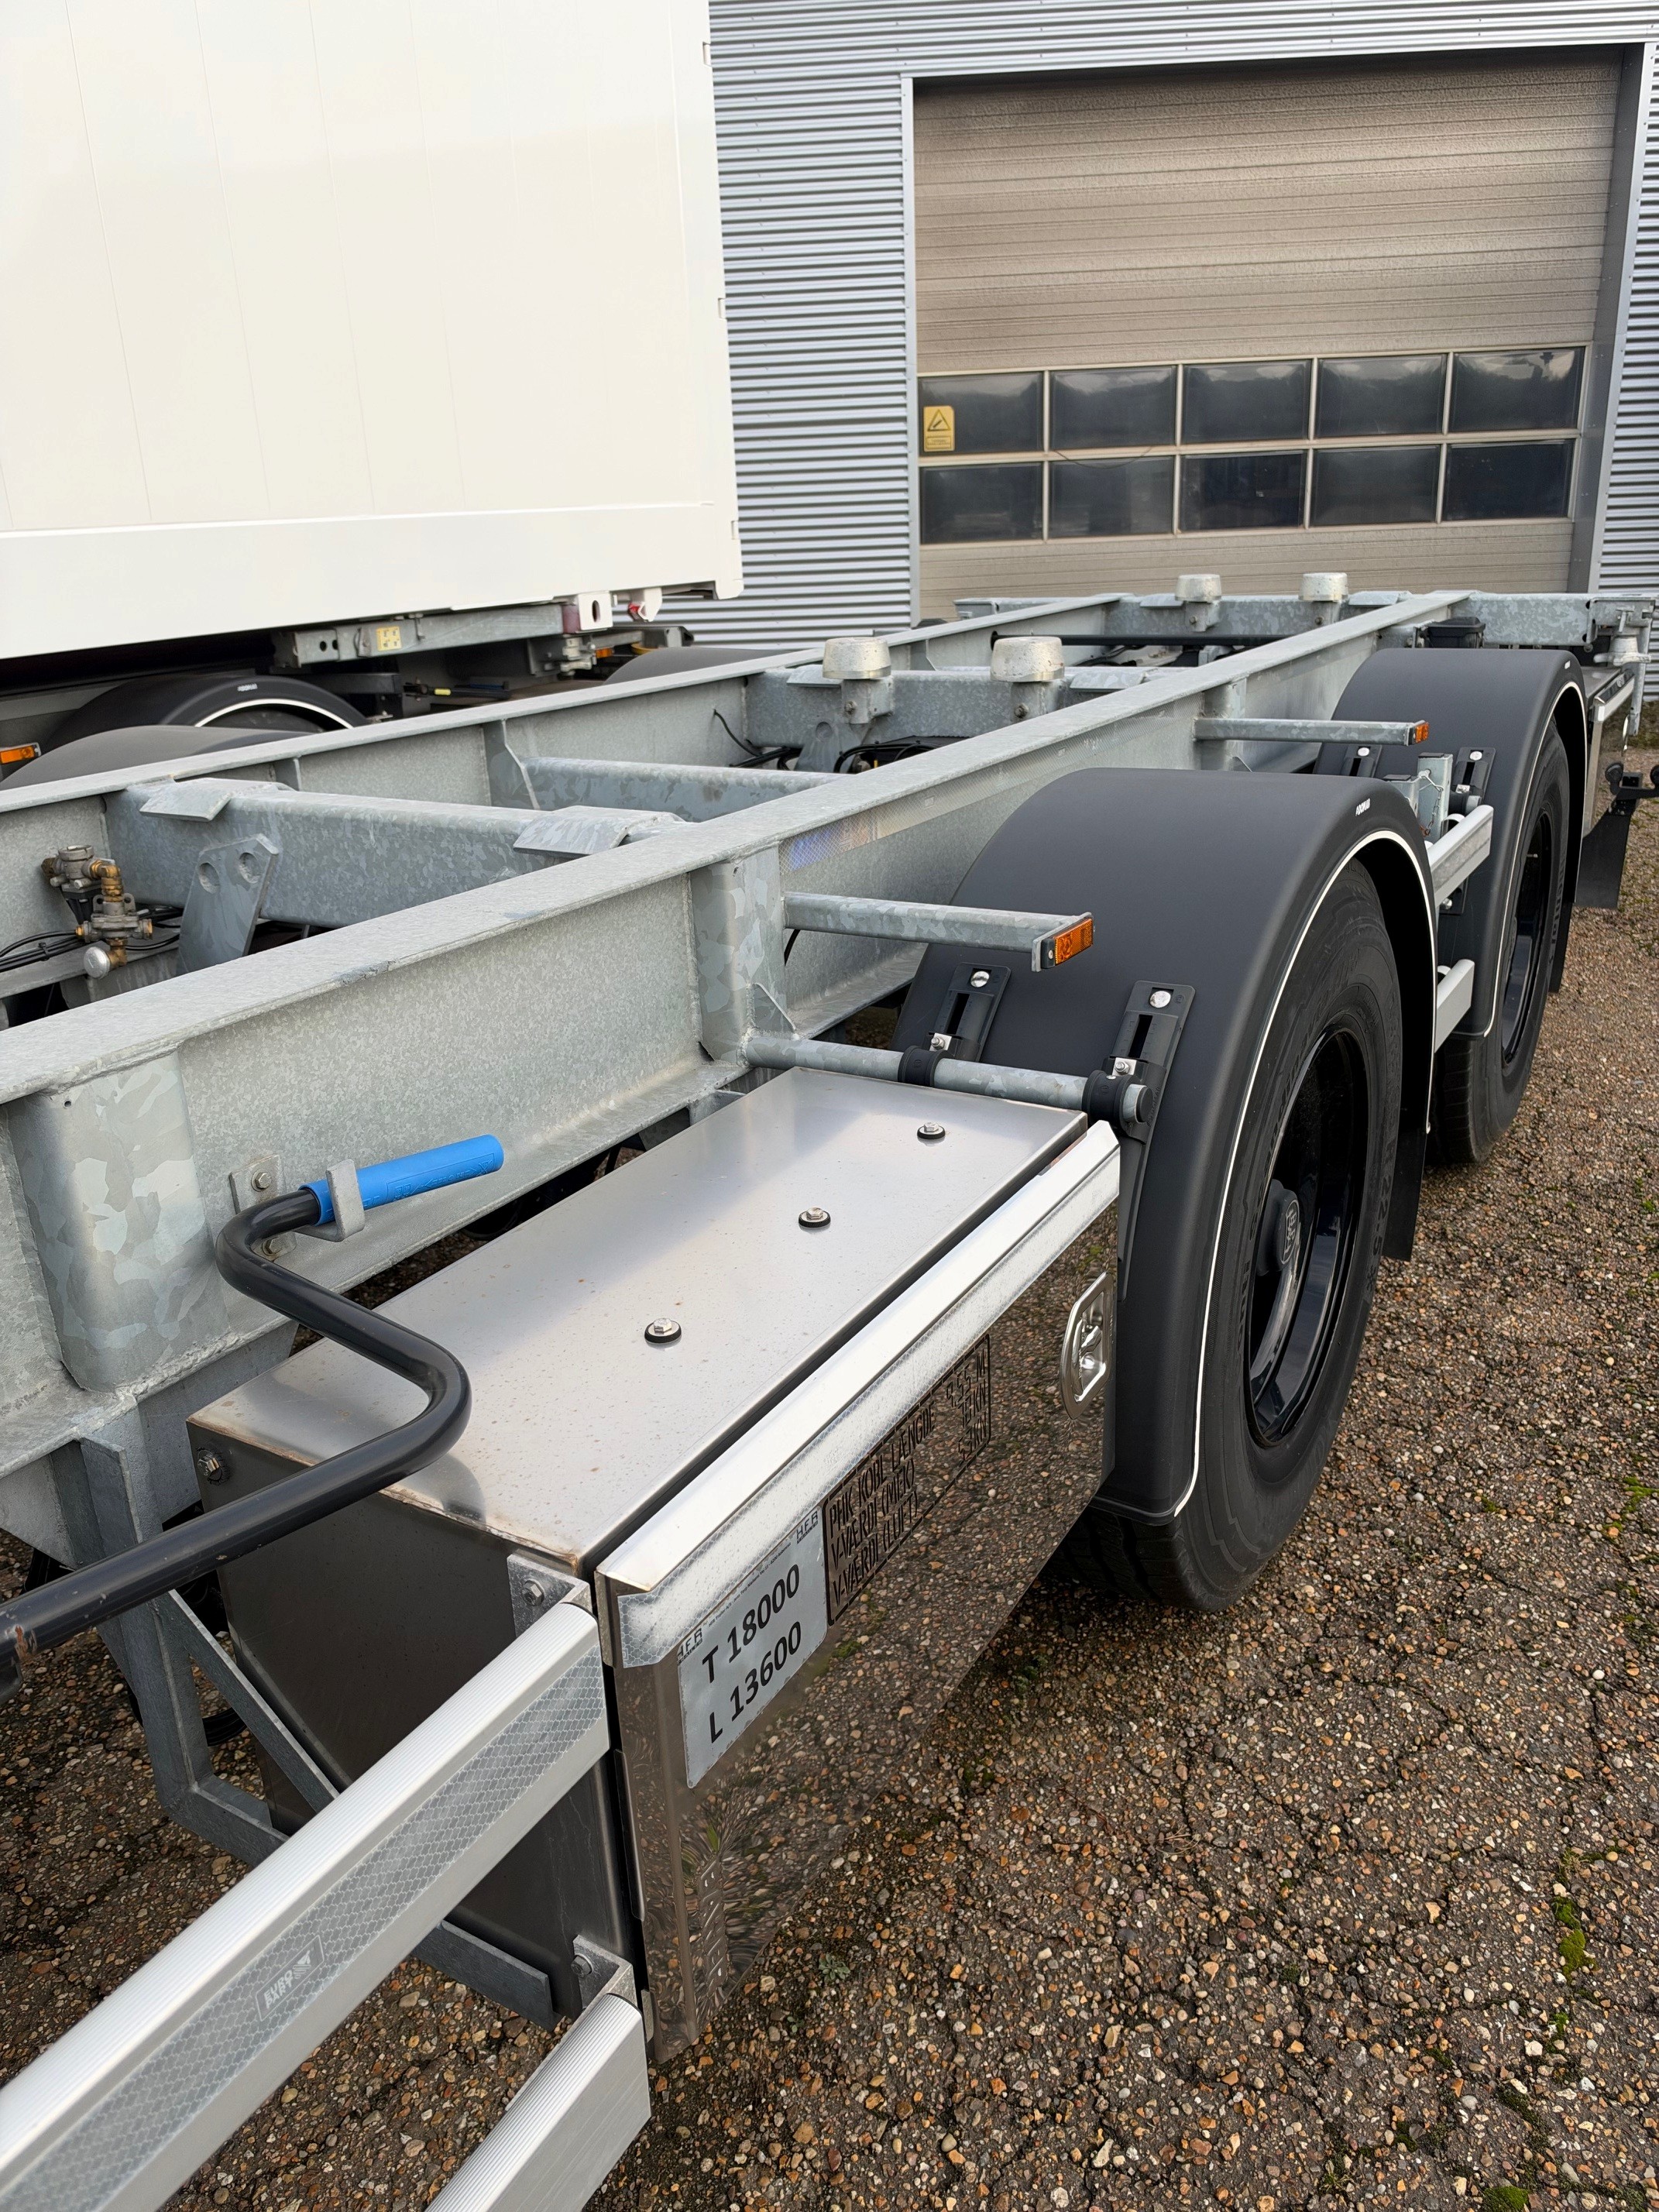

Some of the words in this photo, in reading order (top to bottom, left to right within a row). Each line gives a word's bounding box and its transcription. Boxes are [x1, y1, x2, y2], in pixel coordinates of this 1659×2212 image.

[858, 1455, 888, 1507] KOBL
[891, 1400, 936, 1471] LÆNGDE
[796, 1510, 819, 1541] HFR
[830, 1496, 878, 1571] V-VÆRDI
[833, 1533, 879, 1608] V-VÆRDI
[883, 1489, 918, 1553] (LUFT)
[702, 1645, 719, 1684] T
[727, 1563, 801, 1664] 18000
[709, 1710, 723, 1744] L
[730, 1620, 802, 1722] 13600
[263, 1969, 294, 2001] EURO
[266, 1977, 294, 2009] PART
